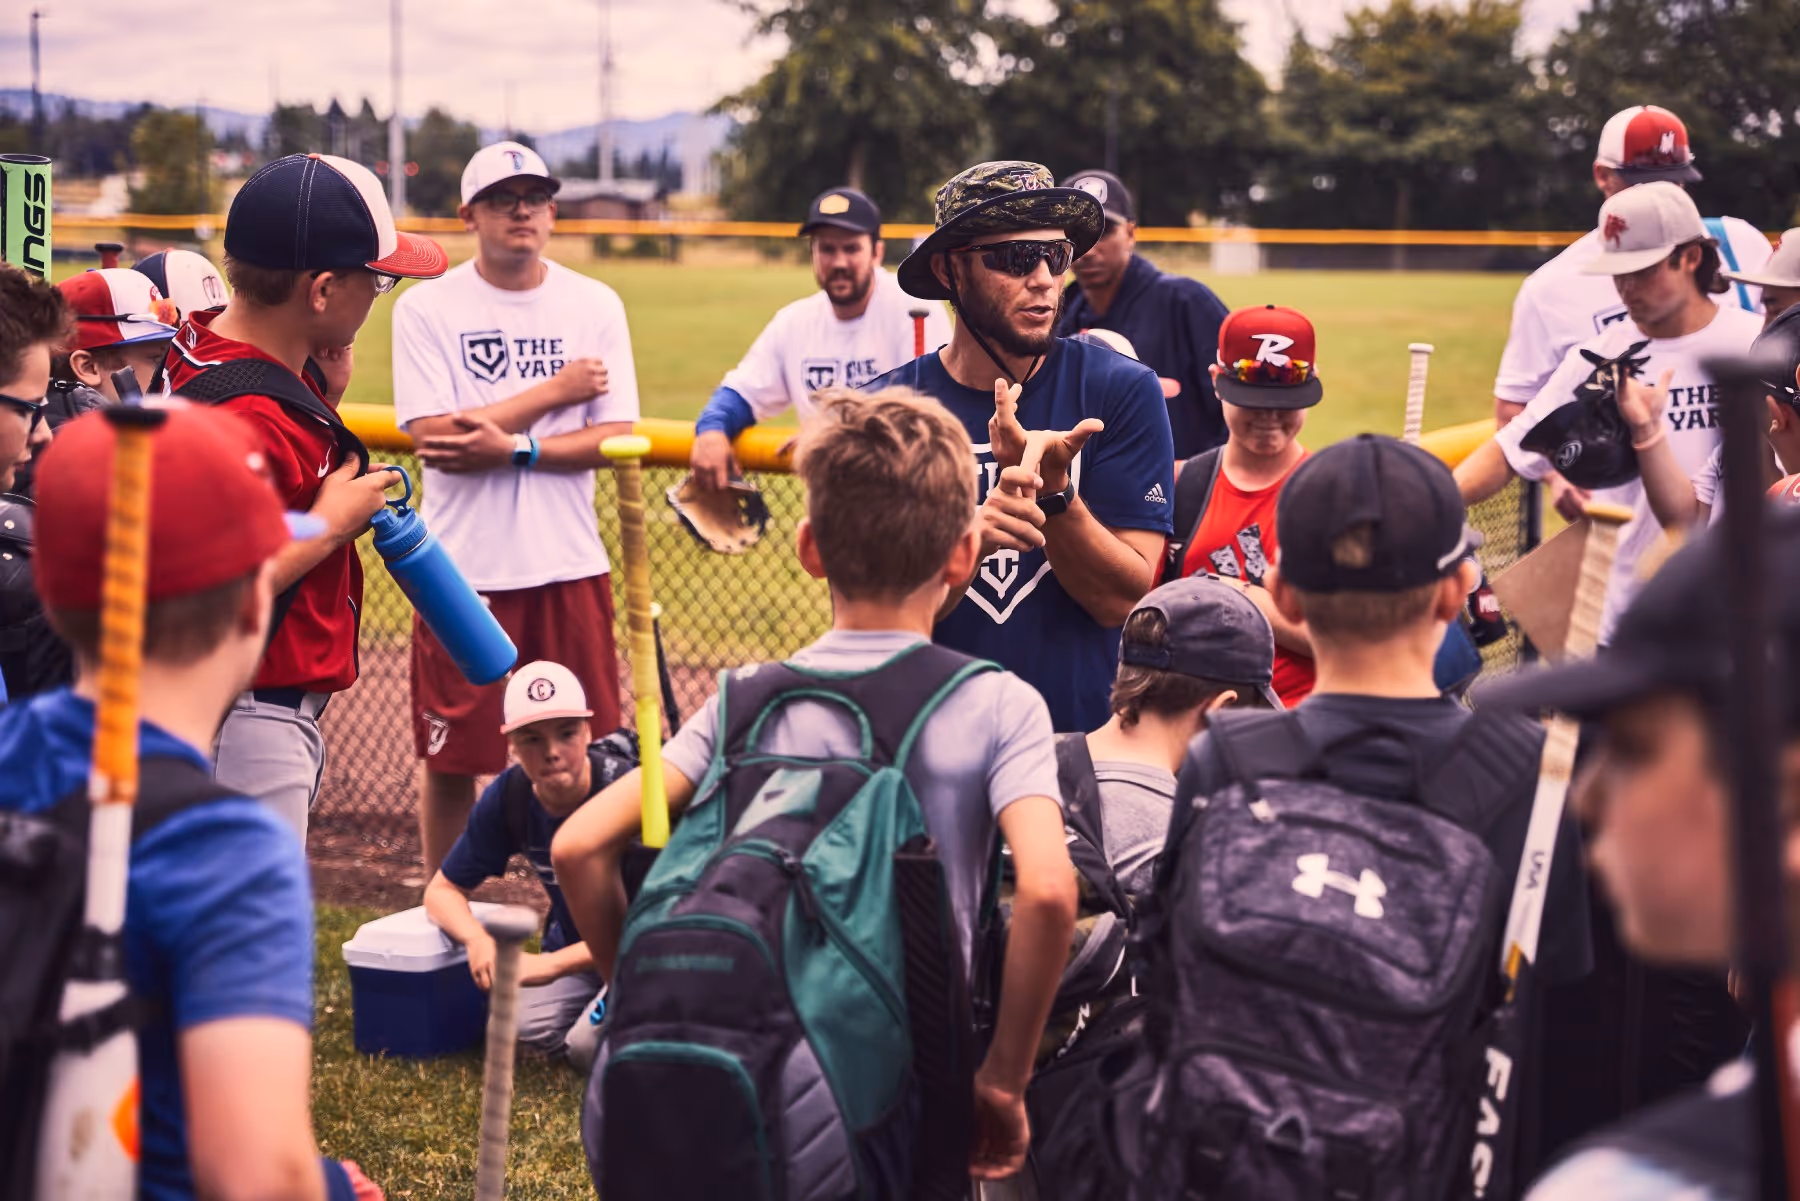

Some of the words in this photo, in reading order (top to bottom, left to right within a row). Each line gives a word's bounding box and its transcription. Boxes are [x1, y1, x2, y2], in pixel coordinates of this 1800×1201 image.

[513, 337, 564, 357] THE
[1251, 333, 1296, 367] R
[516, 359, 571, 379] YAR
[1667, 383, 1719, 407] THE
[1667, 407, 1719, 432] YAR
